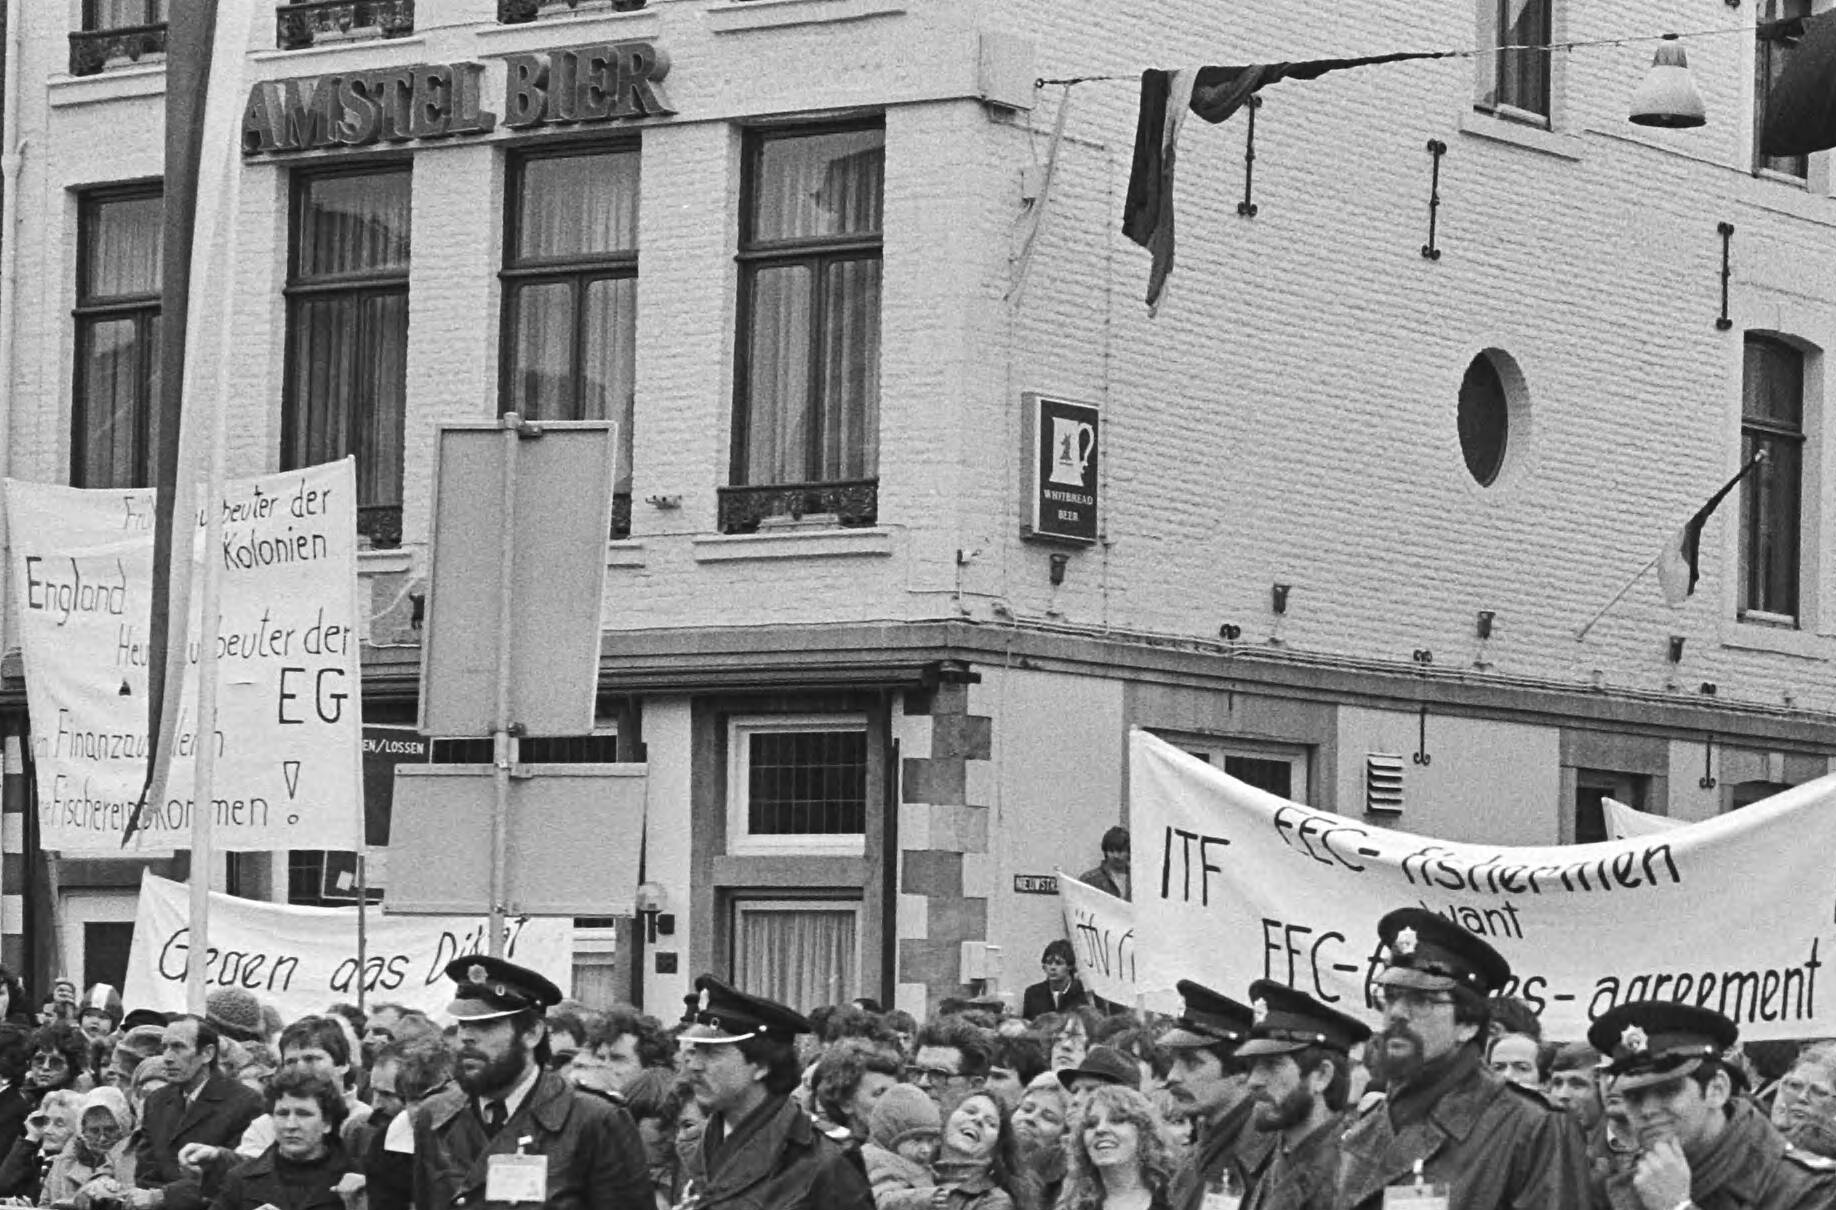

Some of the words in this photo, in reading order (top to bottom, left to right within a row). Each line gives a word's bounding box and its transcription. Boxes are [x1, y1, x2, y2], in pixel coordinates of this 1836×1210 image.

[241, 62, 496, 156] AMSTEL
[502, 41, 680, 129] BIER
[291, 478, 331, 518] der
[223, 526, 328, 571] Kolonien
[26, 556, 126, 627] England
[304, 607, 350, 656] der
[279, 667, 348, 724] EG
[363, 739, 424, 754] EN/LOSSEN
[1162, 826, 1230, 906] ITF
[1401, 844, 1681, 895] fishermen
[329, 954, 410, 993] das
